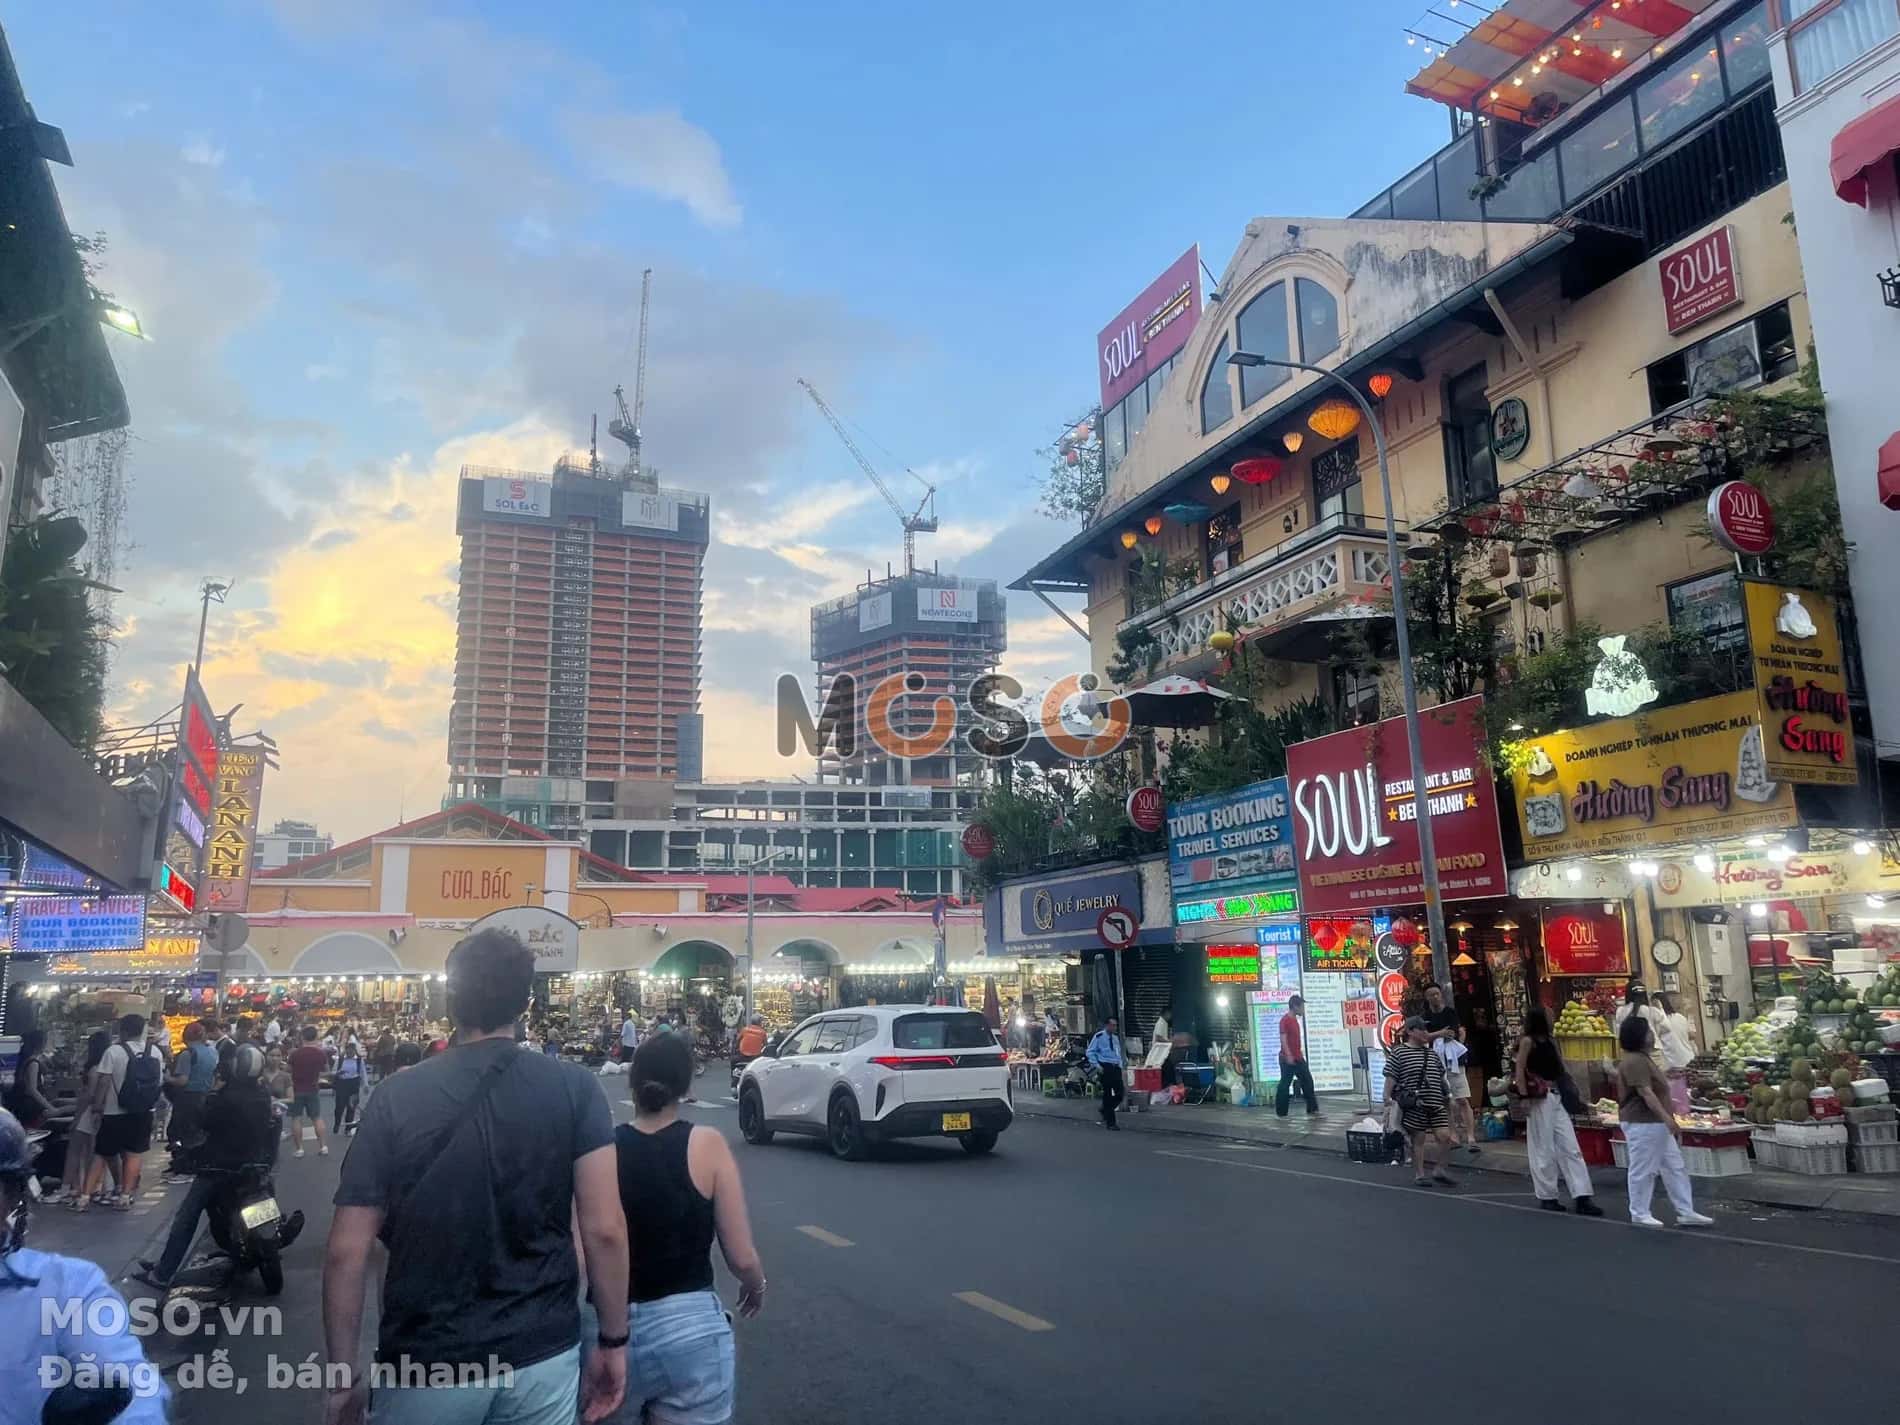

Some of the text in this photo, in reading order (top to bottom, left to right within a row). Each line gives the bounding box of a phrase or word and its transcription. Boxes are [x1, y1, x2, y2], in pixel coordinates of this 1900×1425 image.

[1666, 237, 1728, 300] SOUL
[1104, 321, 1142, 384] SOUL
[1727, 489, 1763, 519] SOUL
[1781, 715, 1846, 764] Sang
[1451, 767, 1472, 783] BAR
[1659, 766, 1731, 811] Sang
[1167, 812, 1211, 839] TOUR
[1212, 793, 1288, 832] BOOKING
[1295, 763, 1391, 861] SOUL
[1176, 825, 1280, 858] TRAVEL SERVICES
[22, 899, 140, 917] TRAVEL SERVICE
[1075, 894, 1120, 913] JEWELRY
[67, 916, 139, 927] BOOKING
[71, 928, 138, 938] BOOKING
[1258, 930, 1294, 944] Tourist
[1567, 921, 1599, 945] SOUL
[31, 939, 57, 949] AIR
[1317, 959, 1332, 969] AIR
[1358, 1000, 1375, 1011] CARD
[1346, 1014, 1358, 1026] 4G
[1364, 1012, 1377, 1025] 5G
